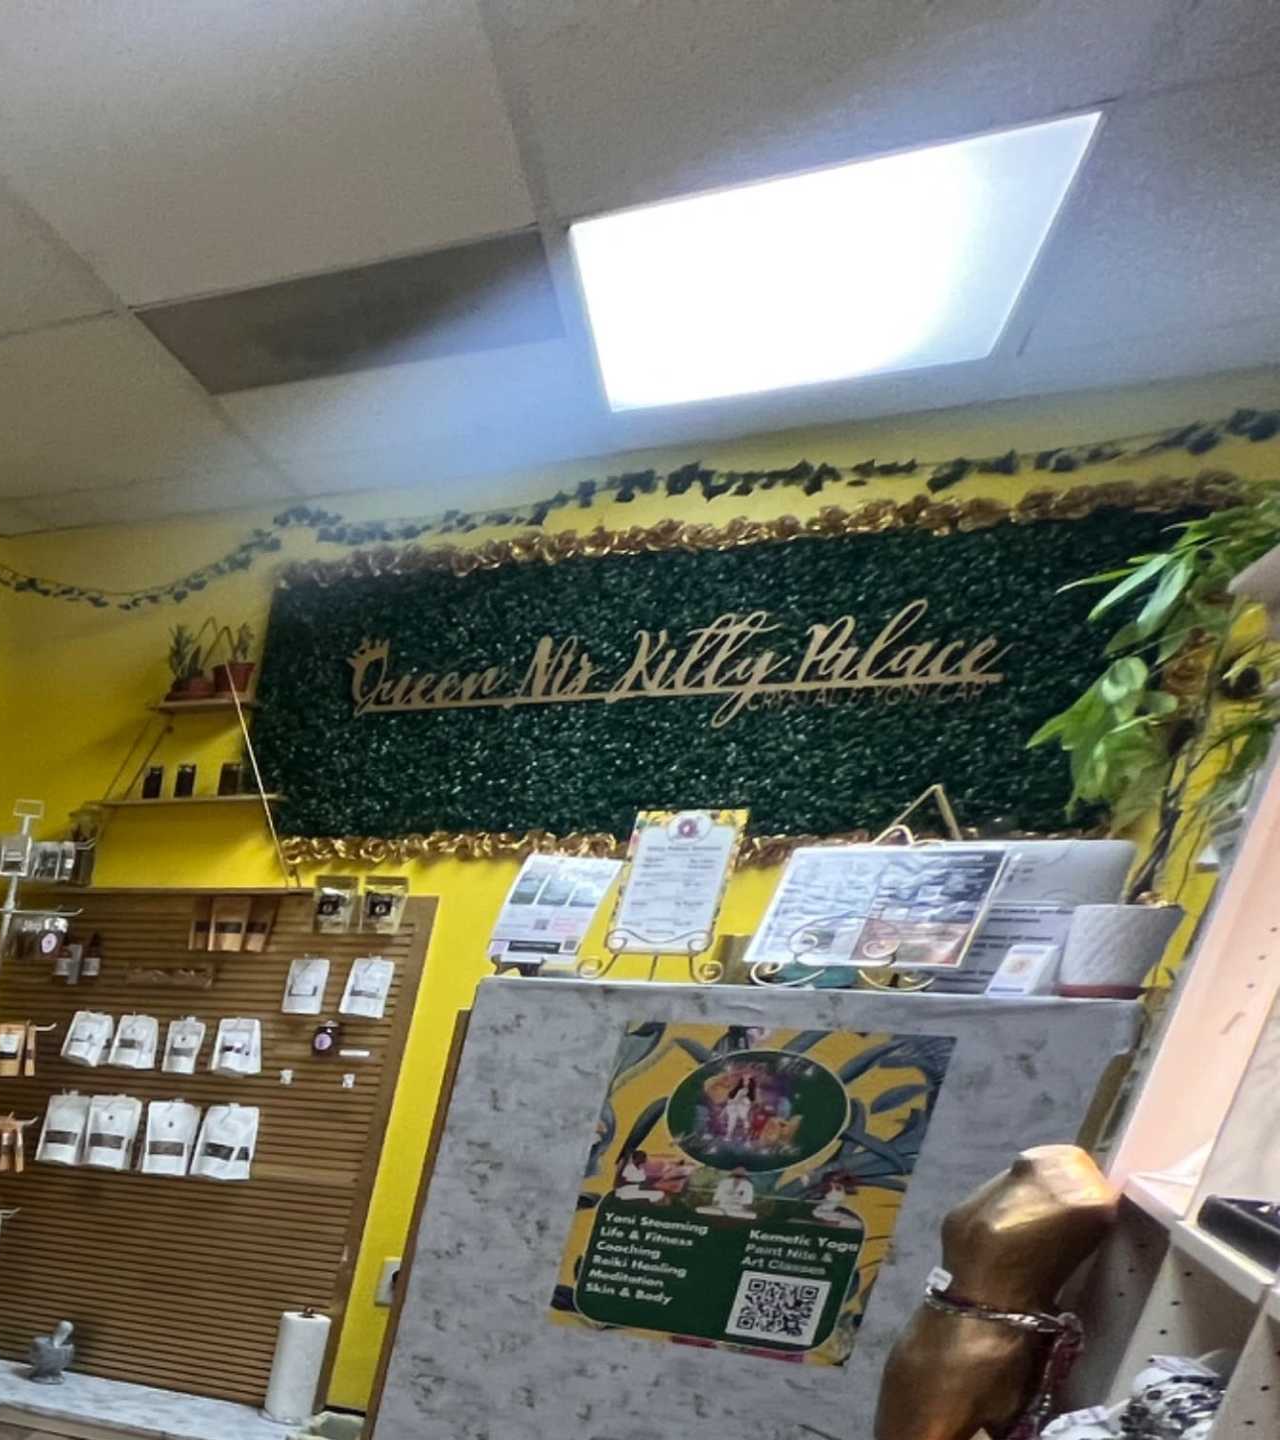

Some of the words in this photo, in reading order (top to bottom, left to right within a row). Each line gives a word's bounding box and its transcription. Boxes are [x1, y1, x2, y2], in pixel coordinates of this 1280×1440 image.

[347, 640, 509, 717] Queen
[605, 610, 792, 728] Kitty
[791, 598, 1016, 688] Palace
[600, 1226, 625, 1239] Life
[595, 1241, 661, 1260] Coaching
[818, 1236, 859, 1253] Yoga
[592, 1254, 628, 1268] Reiki
[631, 1260, 687, 1279] Healing
[742, 1256, 765, 1268] Art
[587, 1268, 664, 1288] Meditation
[635, 1289, 673, 1306] Body
